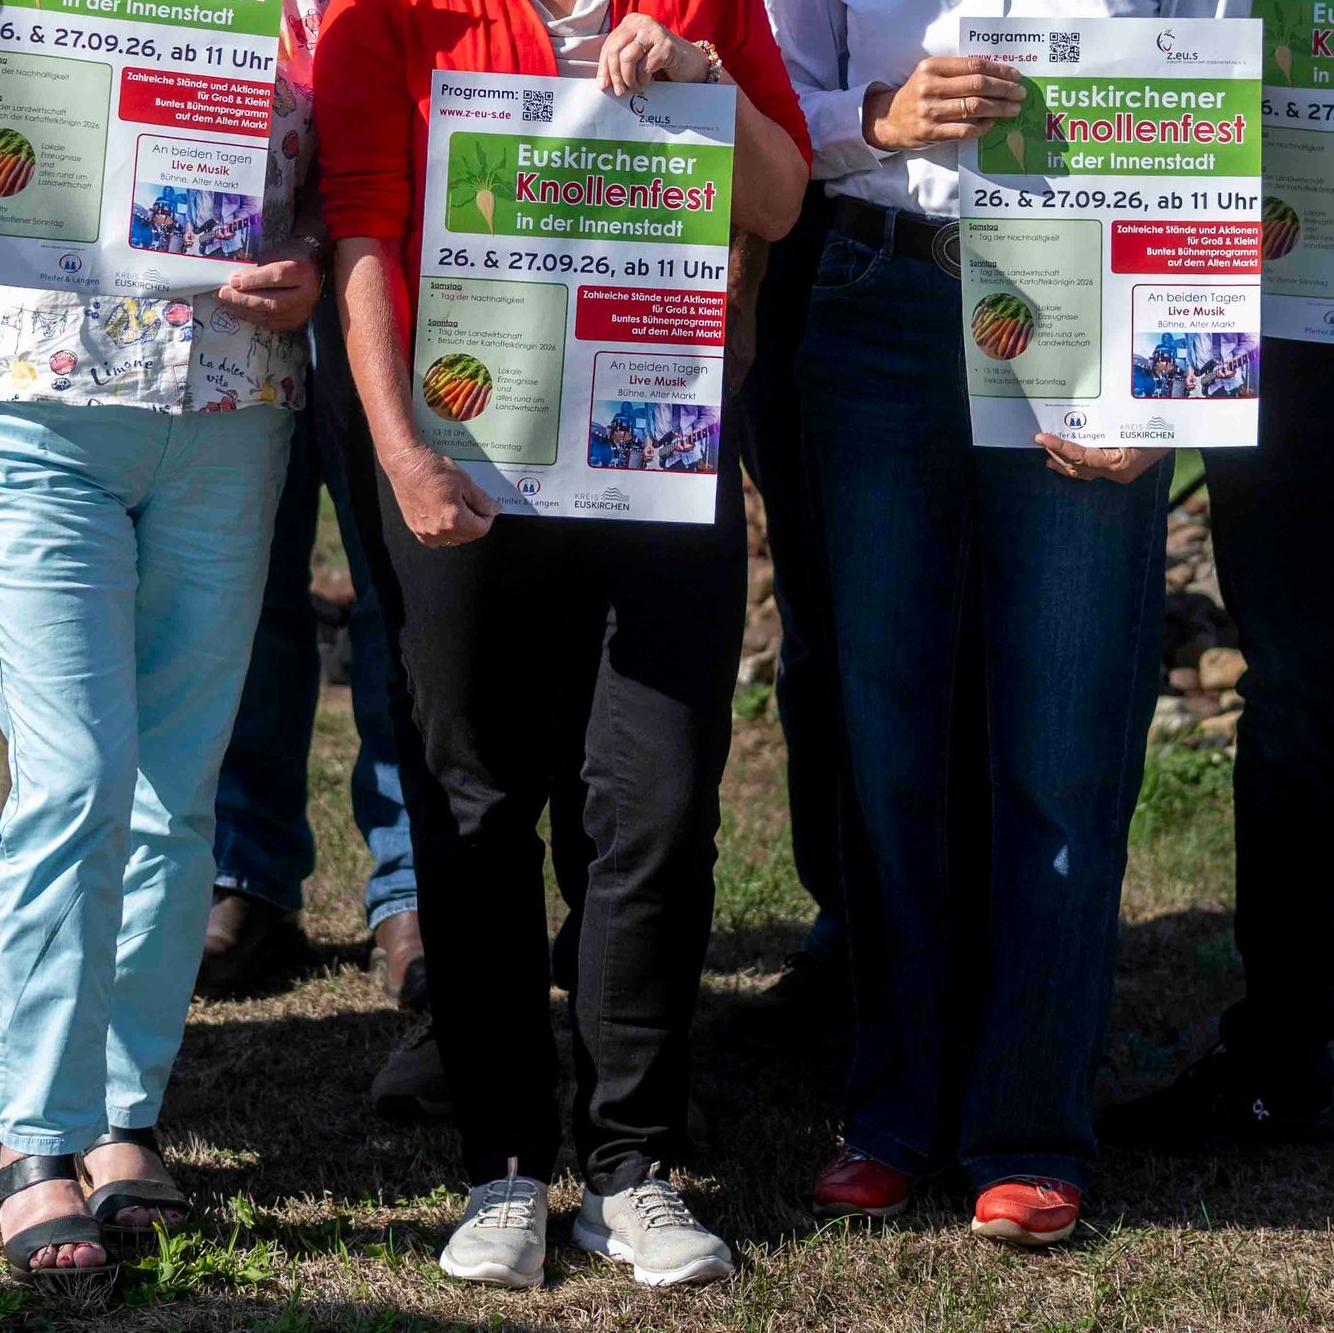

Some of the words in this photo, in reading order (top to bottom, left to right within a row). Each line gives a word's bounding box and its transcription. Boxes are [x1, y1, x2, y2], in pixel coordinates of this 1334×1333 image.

[969, 30, 1045, 44] Programm:
[29, 26, 45, 43] &
[53, 27, 162, 60] 27.09.26,
[170, 42, 197, 62] ab
[204, 46, 222, 65] 11
[231, 49, 274, 71] Uhr
[1166, 51, 1198, 60] z.eu.s
[1313, 66, 1328, 82] in
[440, 84, 519, 102] Programm:
[1046, 84, 1225, 109] Euskirchener
[439, 107, 511, 119] www.z-eu-s.de
[1261, 99, 1279, 116] 6.
[1285, 102, 1299, 118] &
[175, 111, 194, 121] auf
[195, 113, 213, 123] dem
[215, 116, 239, 126] Alten
[241, 118, 267, 129] Markt
[639, 114, 670, 124] z.eu.s
[1045, 110, 1247, 145] Knollenfest
[171, 159, 194, 171] Live
[196, 162, 229, 176] Musik
[518, 143, 696, 175] Euskirchener
[1047, 152, 1063, 168] in
[1072, 151, 1103, 168] der
[1110, 152, 1215, 170] Innenstadt
[515, 170, 717, 213] Knollenfest
[975, 189, 1009, 207] 26.
[1017, 191, 1032, 207] &
[1041, 190, 1148, 211] 27.09.26,
[1157, 192, 1182, 209] ab
[1190, 192, 1206, 209] 11
[1217, 192, 1257, 210] Uhr
[516, 212, 533, 229] in
[541, 213, 572, 231] der
[579, 215, 683, 237] Innenstadt
[1117, 224, 1163, 234] Zahlreiche
[1166, 225, 1196, 234] Stände
[1198, 226, 1215, 234] und
[1218, 226, 1257, 234] Aktionen
[1187, 236, 1198, 244] für
[1201, 237, 1222, 245] Groß
[1234, 236, 1257, 245] Klein!
[1147, 247, 1176, 255] Buntes
[1178, 247, 1257, 258] Bühnenprogramm
[438, 247, 476, 267] 26.
[483, 251, 499, 268] &
[508, 251, 616, 276] 27.09.26,
[624, 258, 649, 276] ab
[656, 259, 673, 277] 11
[683, 260, 724, 280] Uhr
[1168, 258, 1185, 266] auf
[1188, 258, 1205, 266] dem
[1207, 259, 1230, 267] Alten
[1233, 258, 1257, 266] Markt
[1168, 306, 1190, 315] Live
[1193, 306, 1224, 315] Musik
[90, 358, 154, 386] Limone
[199, 353, 213, 368] La
[218, 357, 246, 378] dolce
[610, 359, 626, 370] An
[628, 360, 669, 373] beiden
[672, 363, 707, 377] Tagen
[207, 375, 229, 388] vita
[629, 374, 651, 385] Live
[654, 376, 686, 387] Musik
[574, 500, 629, 511] EUSKIRCHEN
